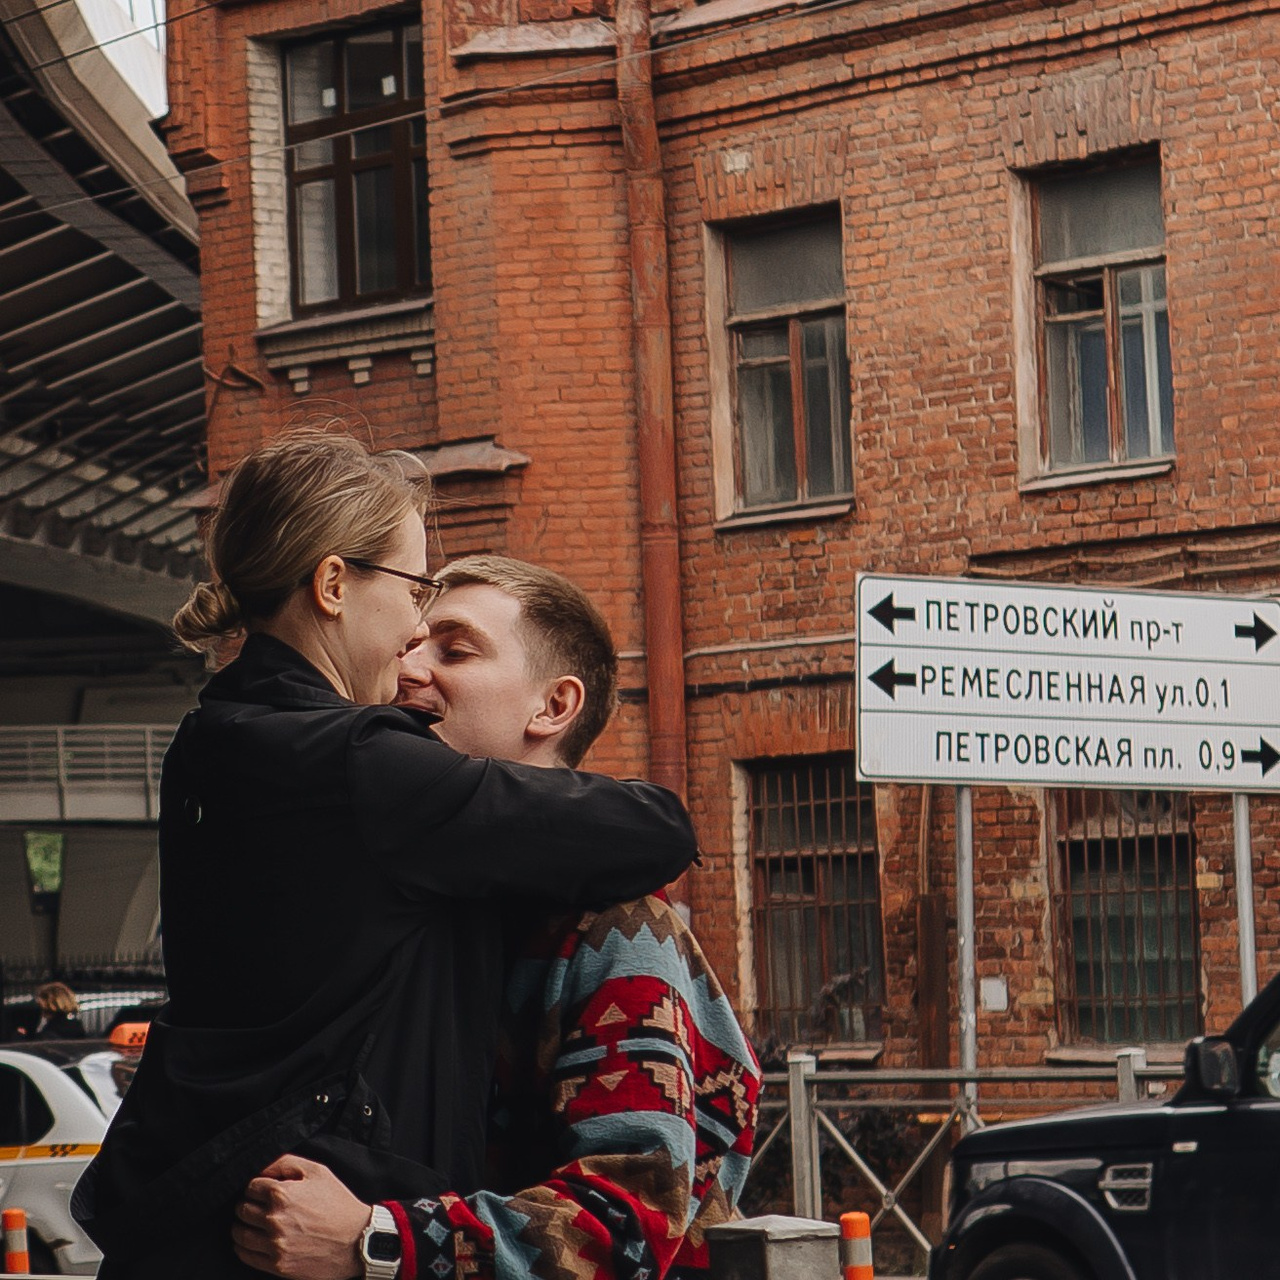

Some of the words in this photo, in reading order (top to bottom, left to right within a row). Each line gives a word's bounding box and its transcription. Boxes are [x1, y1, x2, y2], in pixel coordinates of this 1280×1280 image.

[925, 598, 1119, 640] ПЕТРОВСКИЙ
[1130, 620, 1184, 651] пр-т
[921, 664, 1146, 705] РЕМЕСЛЕННАЯ
[935, 730, 1133, 769] ПЕТРОВСКАЯ
[1143, 747, 1182, 770] пл.
[1198, 739, 1236, 775] 0,9
